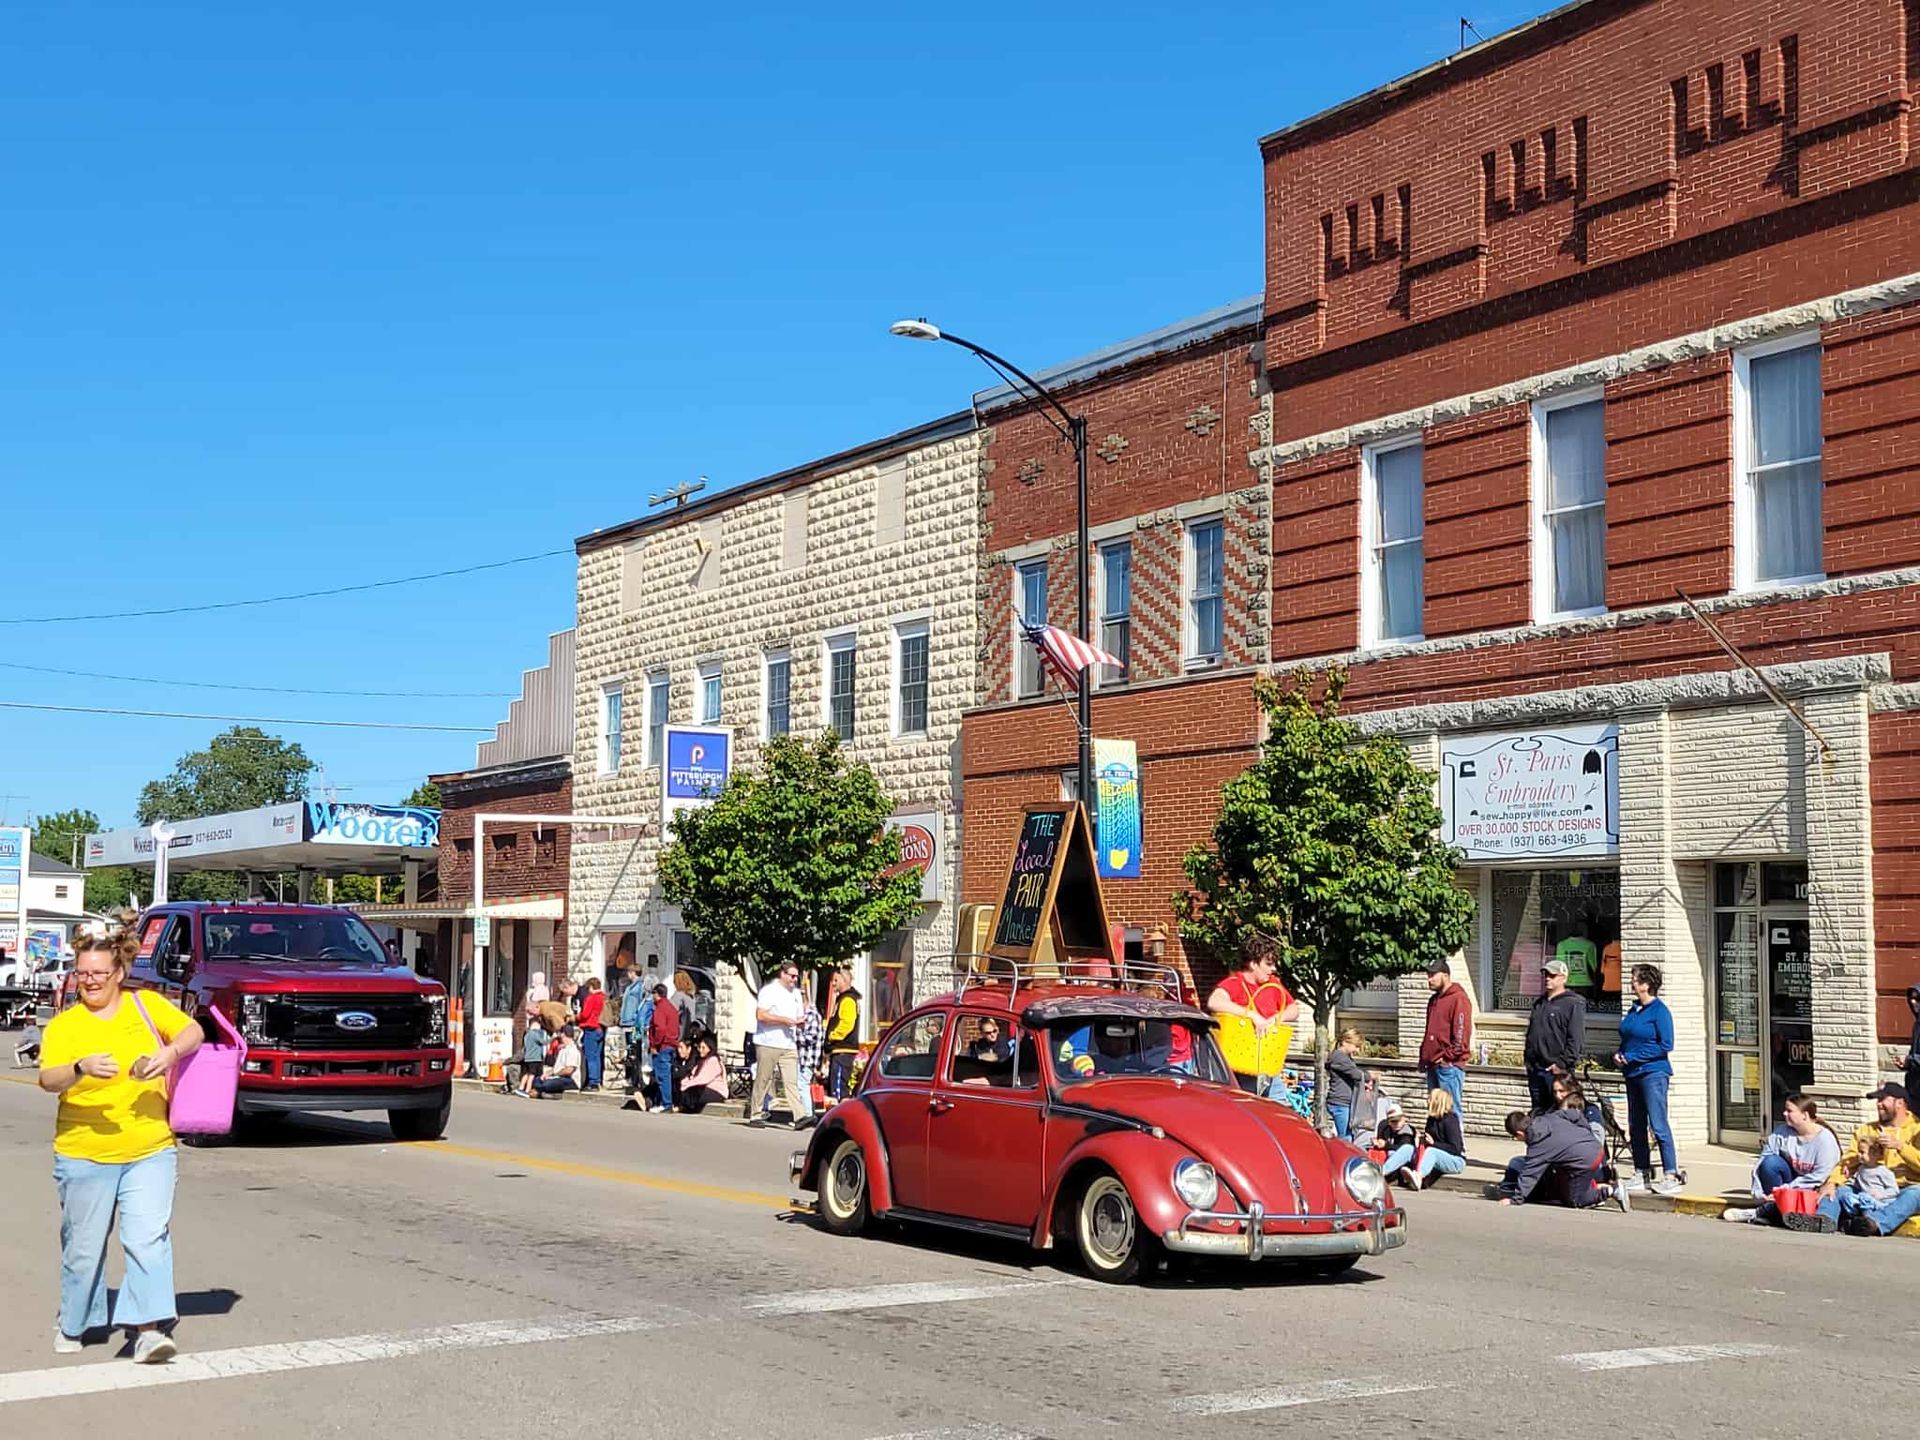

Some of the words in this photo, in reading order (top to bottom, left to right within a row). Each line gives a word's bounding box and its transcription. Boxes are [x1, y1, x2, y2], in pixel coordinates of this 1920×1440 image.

[1488, 752, 1518, 782] St.
[1528, 748, 1573, 773] Paris
[1485, 778, 1578, 805] Embroidery
[308, 801, 435, 848] Wooten
[1031, 814, 1060, 838] THE
[1458, 824, 1482, 836] OVER
[1485, 822, 1519, 835] 30,000
[1522, 820, 1554, 833] STOCK
[1558, 817, 1602, 831] DESIGNS
[1473, 838, 1504, 848] Phone:
[1510, 835, 1535, 848] (937)
[1538, 833, 1587, 846] 663-4936
[1013, 873, 1045, 909] PAIR
[1795, 883, 1809, 899] 10
[997, 907, 1039, 944] Market
[1791, 1043, 1812, 1061] OPE
